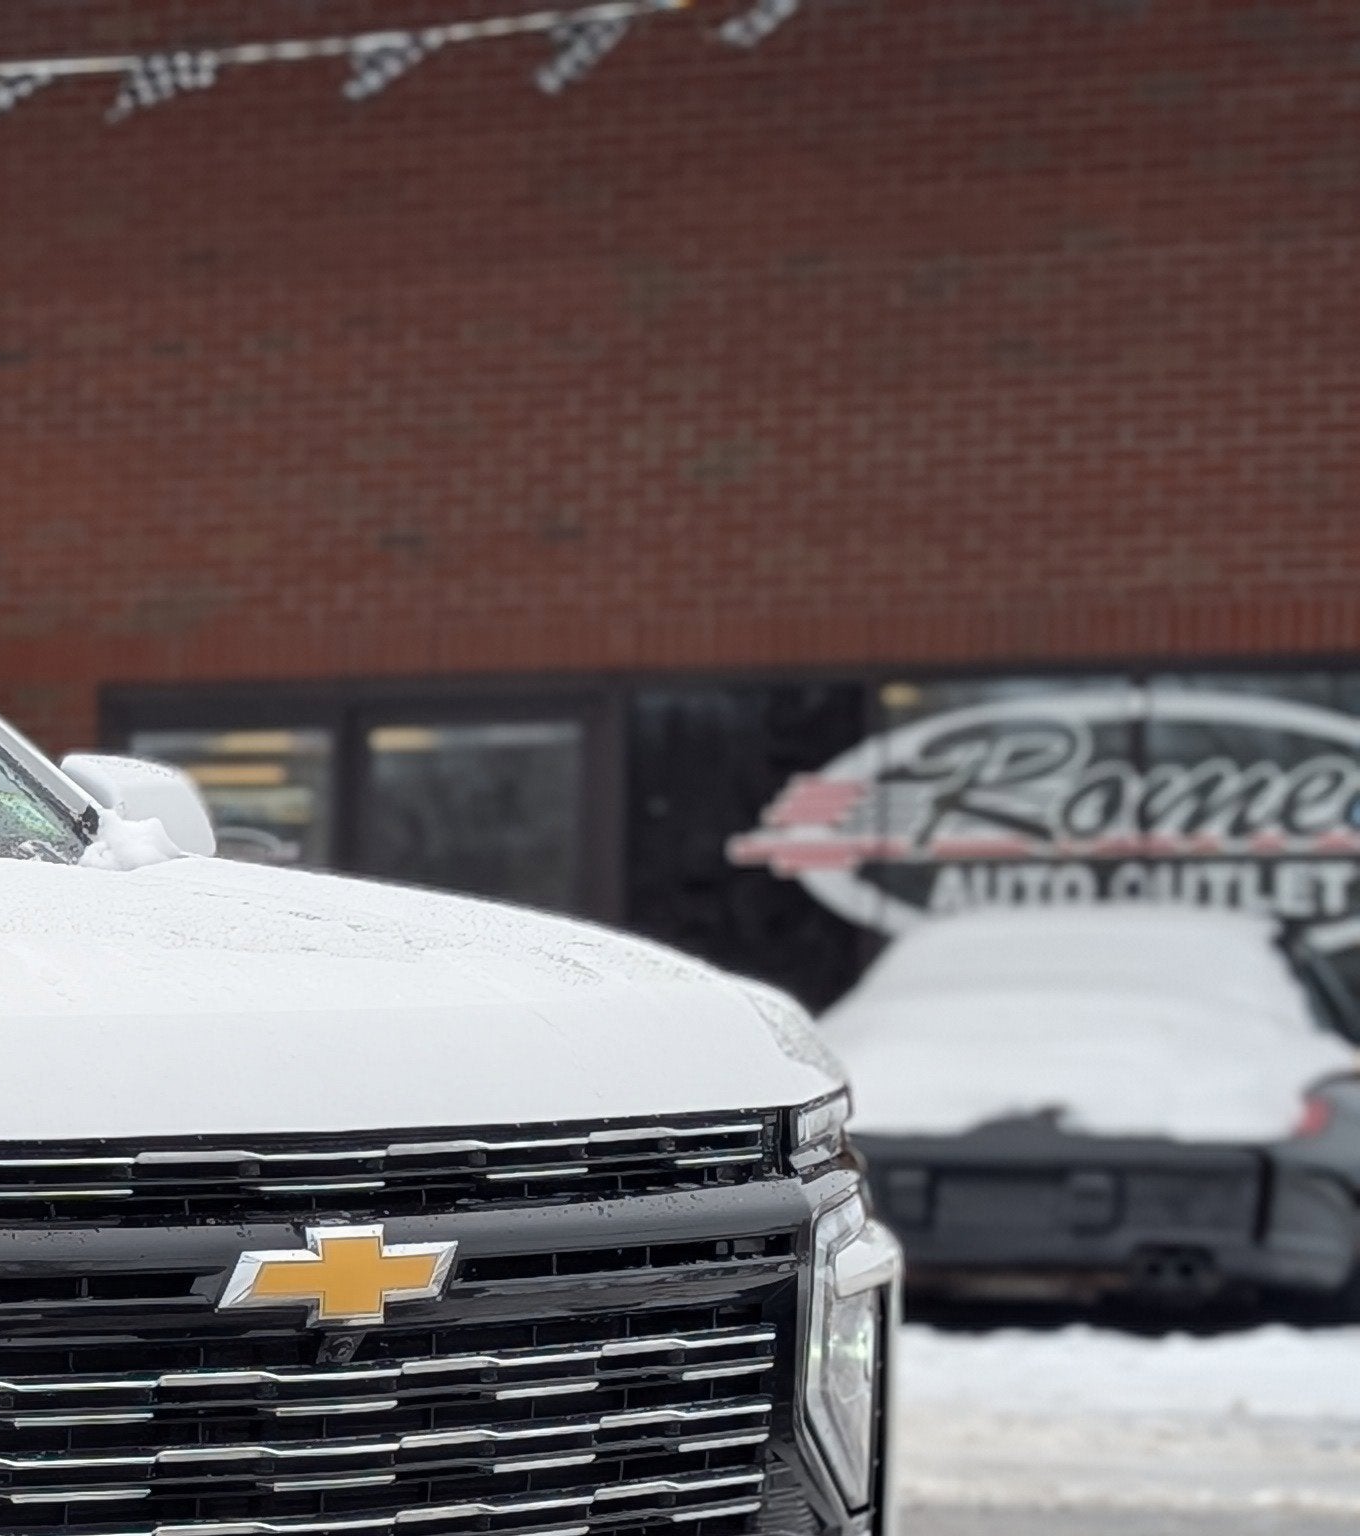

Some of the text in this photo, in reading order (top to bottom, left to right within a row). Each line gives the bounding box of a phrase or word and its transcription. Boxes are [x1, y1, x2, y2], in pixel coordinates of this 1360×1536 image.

[875, 714, 1360, 856] Rome
[929, 860, 1356, 915] AUTO OUTLET
